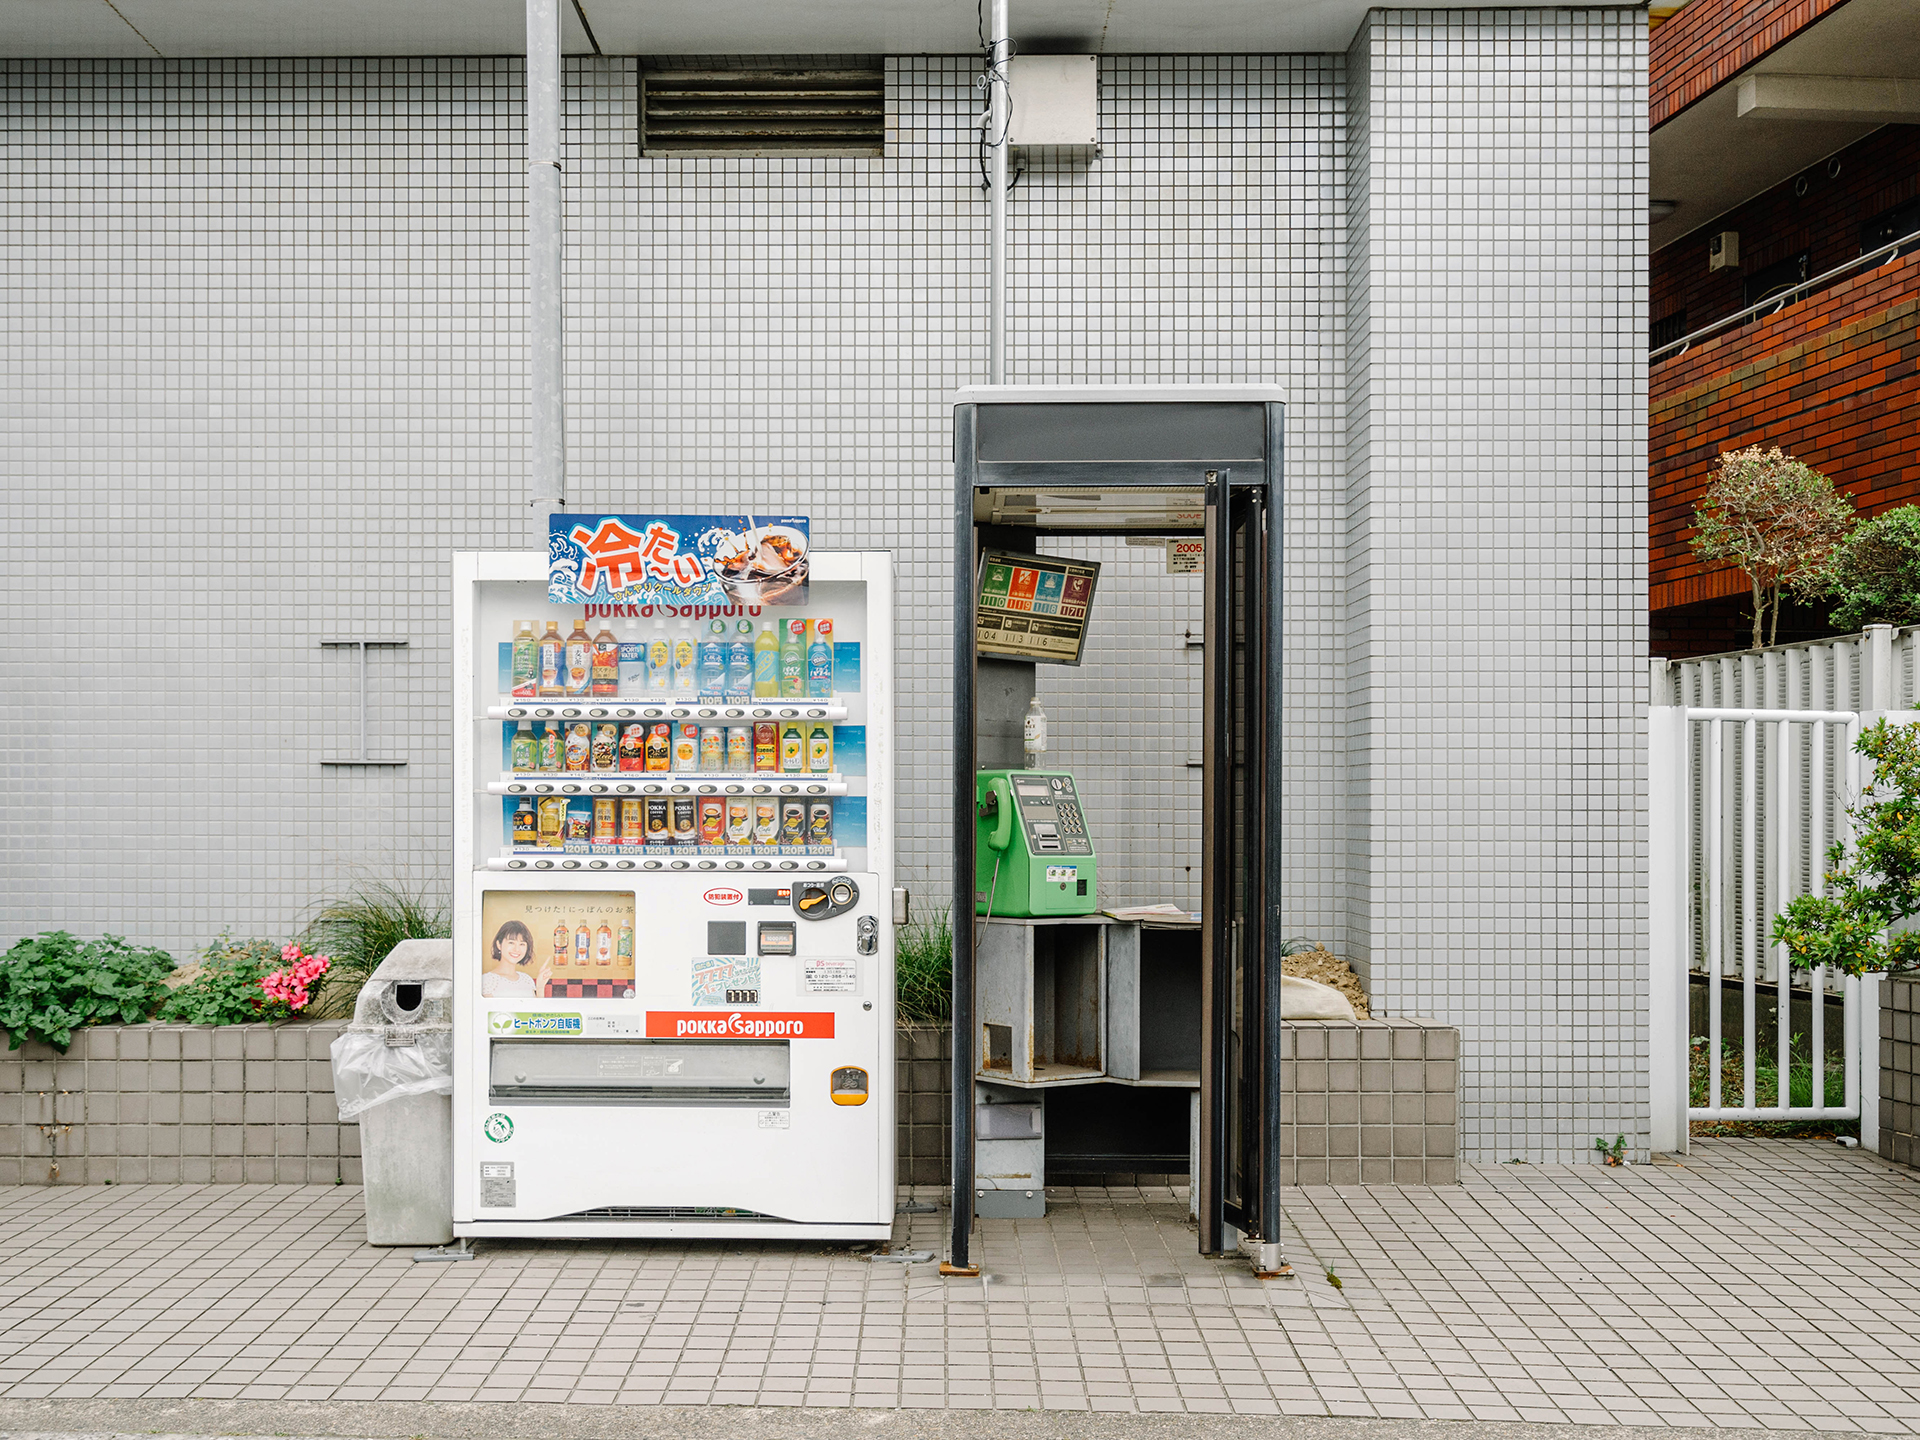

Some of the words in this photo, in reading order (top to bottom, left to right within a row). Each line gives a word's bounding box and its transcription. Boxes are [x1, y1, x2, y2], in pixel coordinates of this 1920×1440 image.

[613, 583, 712, 601] ひんやりクールダウン
[983, 596, 1004, 606] 110
[1009, 600, 1031, 609] 119
[1036, 603, 1056, 613] 118
[1063, 607, 1083, 617] 171
[978, 630, 996, 639] 104
[1005, 633, 1024, 644] 113
[1029, 635, 1047, 646] 116
[699, 696, 723, 705] 110円
[726, 696, 750, 705] 110円
[564, 845, 589, 854] 120円
[592, 846, 616, 854] 120円
[618, 846, 643, 855] 120円
[646, 846, 670, 855] 120円
[673, 846, 697, 855] 120円
[700, 846, 725, 855] 120円
[727, 846, 751, 855] 120円
[754, 846, 778, 855] 120円
[781, 846, 806, 855] 120円
[808, 846, 832, 855] 120円
[695, 964, 733, 984] 7777
[514, 1018, 580, 1030] ヒートポンプ自販機
